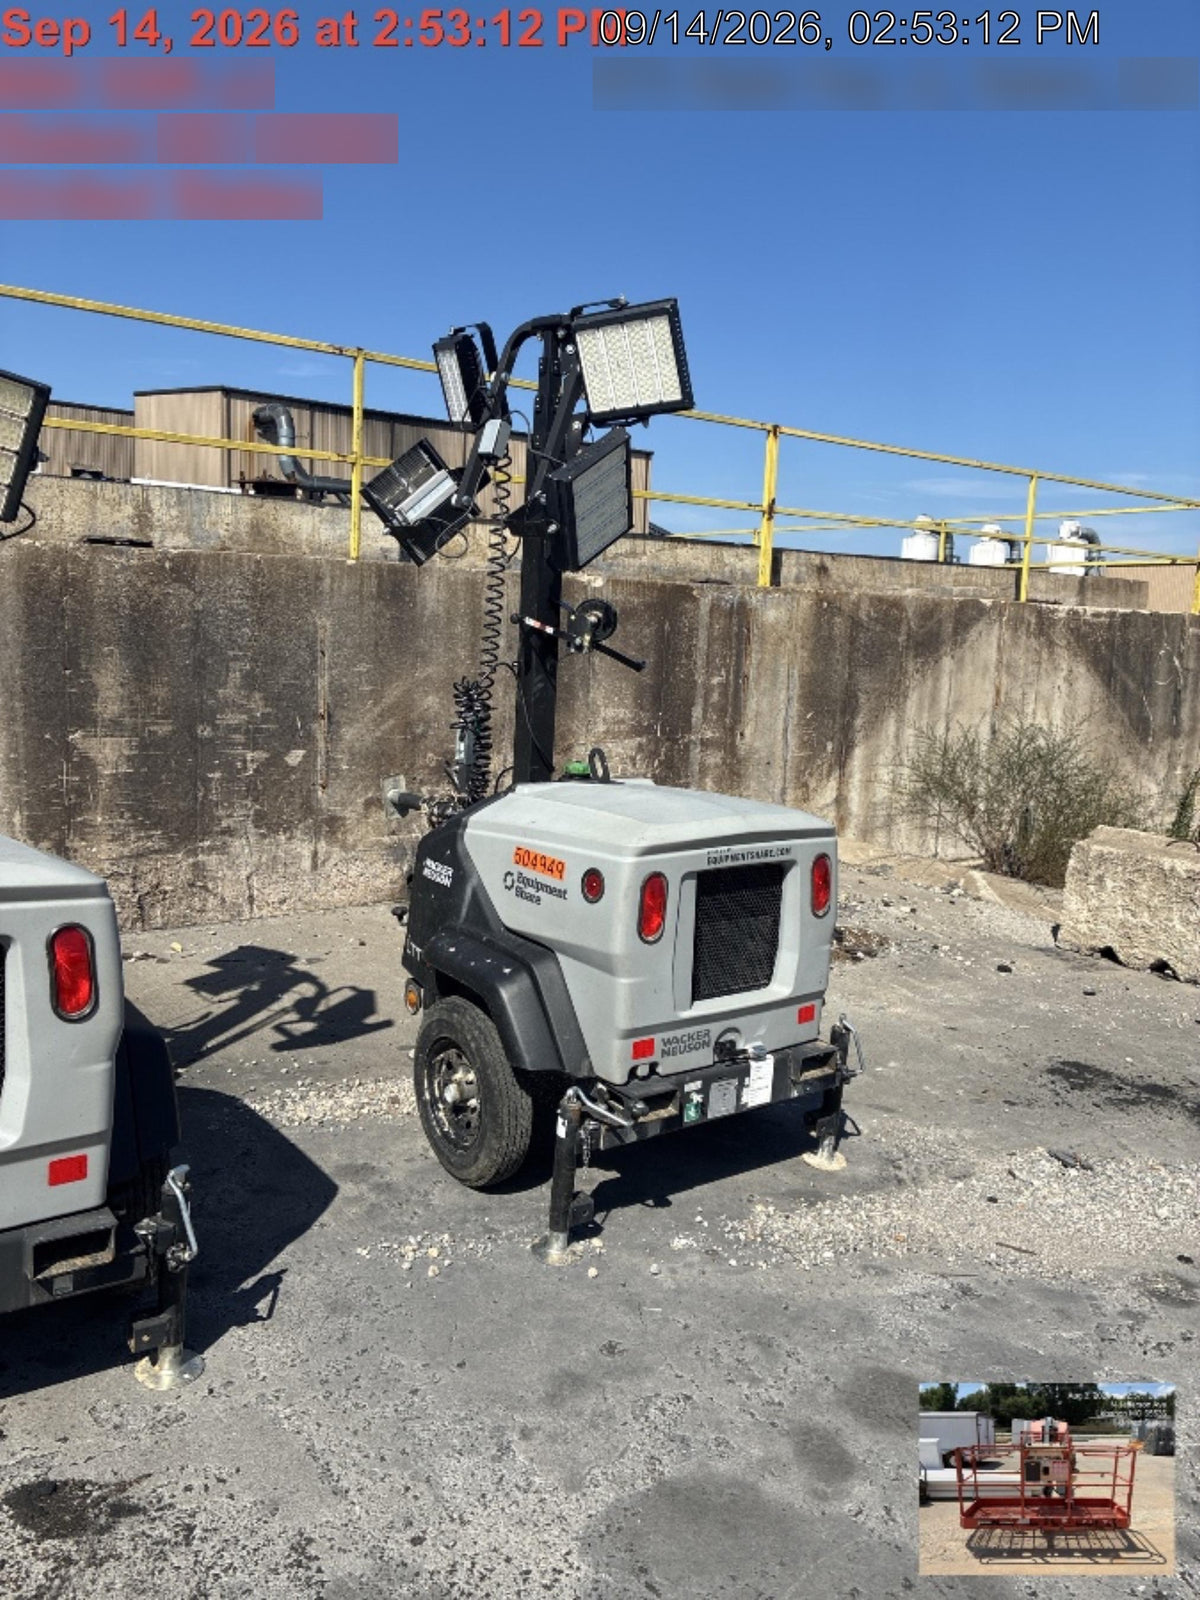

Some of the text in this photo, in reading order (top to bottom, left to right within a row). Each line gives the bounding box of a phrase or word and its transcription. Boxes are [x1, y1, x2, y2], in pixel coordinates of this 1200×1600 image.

[514, 846, 565, 880] 504949
[517, 871, 568, 900] Equipment
[661, 1029, 711, 1048] WACKER
[661, 1040, 711, 1058] NEUSON
